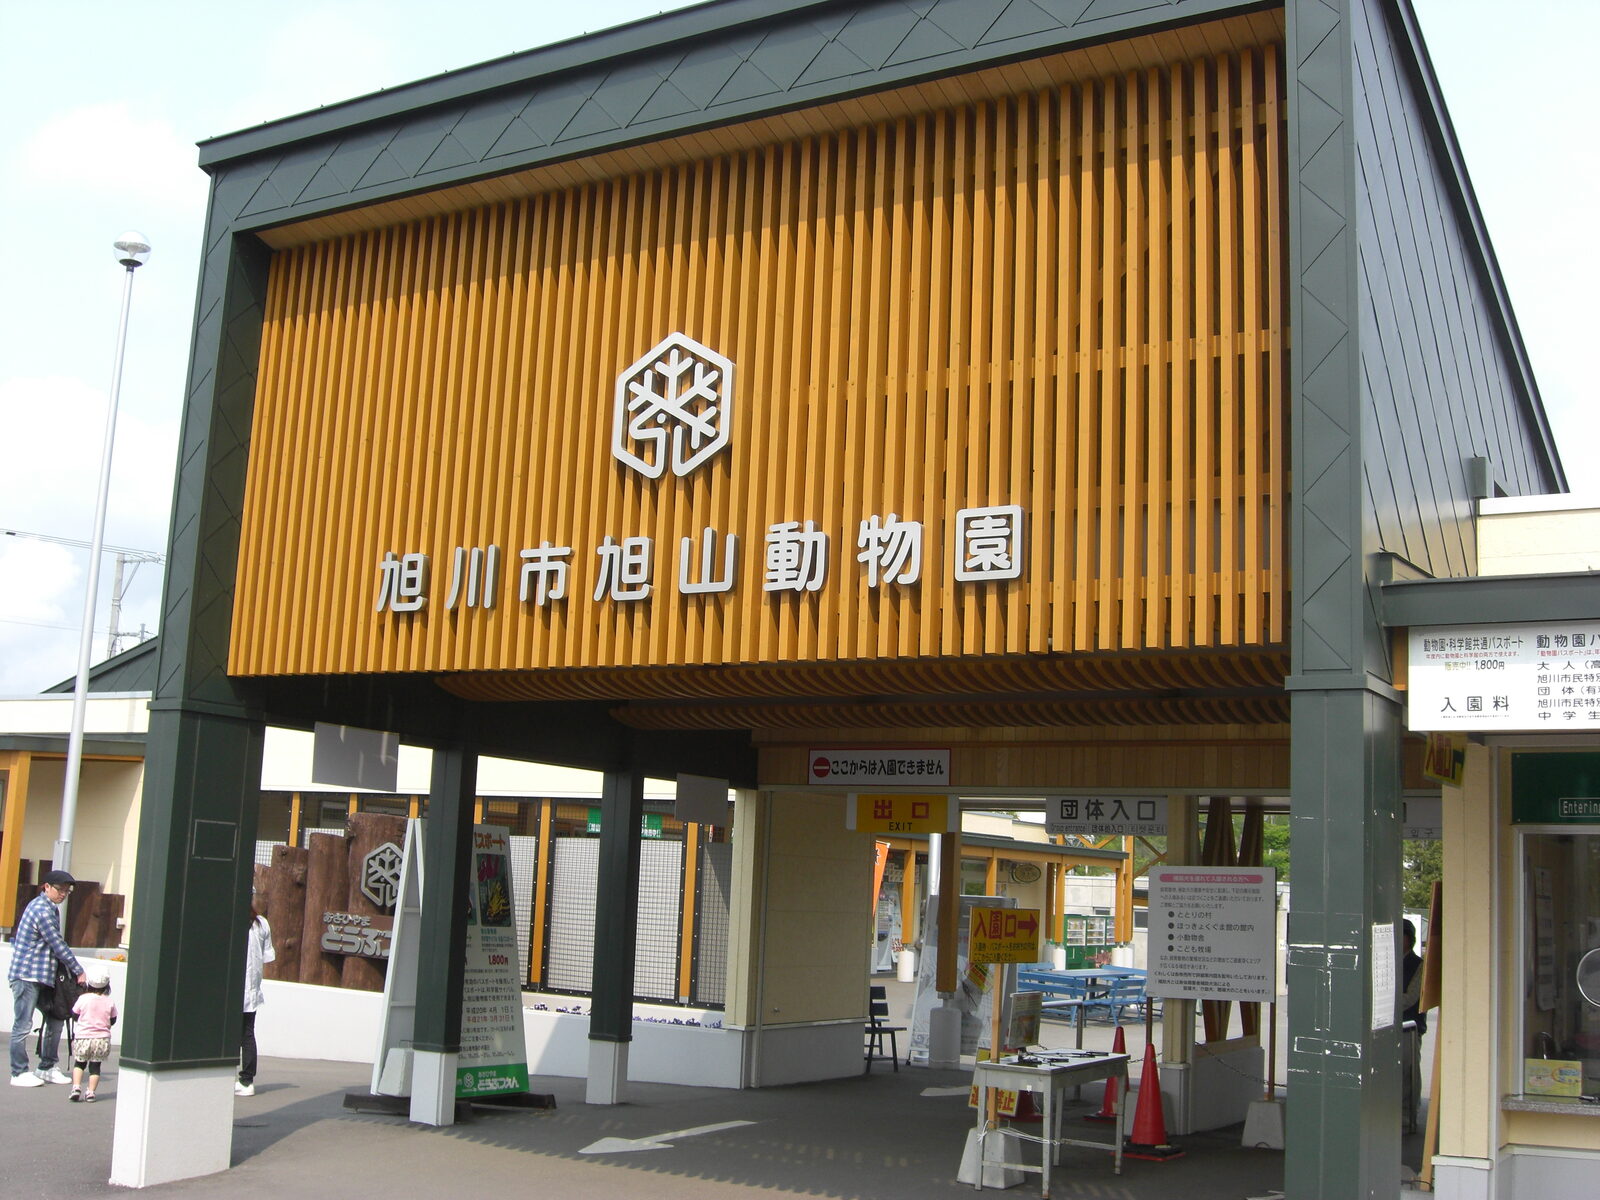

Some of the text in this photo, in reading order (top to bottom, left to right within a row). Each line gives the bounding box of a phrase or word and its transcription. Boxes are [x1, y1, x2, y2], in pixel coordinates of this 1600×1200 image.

[376, 503, 1025, 612] 旭川市旭山動物園
[1423, 635, 1524, 652] 動物園・科学館共通パスポート
[1440, 695, 1510, 712] 入園料
[830, 759, 945, 776] ここからは入園できません
[873, 799, 930, 820] 出口
[1060, 798, 1156, 820] 団体入口
[888, 821, 913, 831] EXIT
[323, 911, 371, 926] あさひやま
[973, 910, 1017, 939] 入園口
